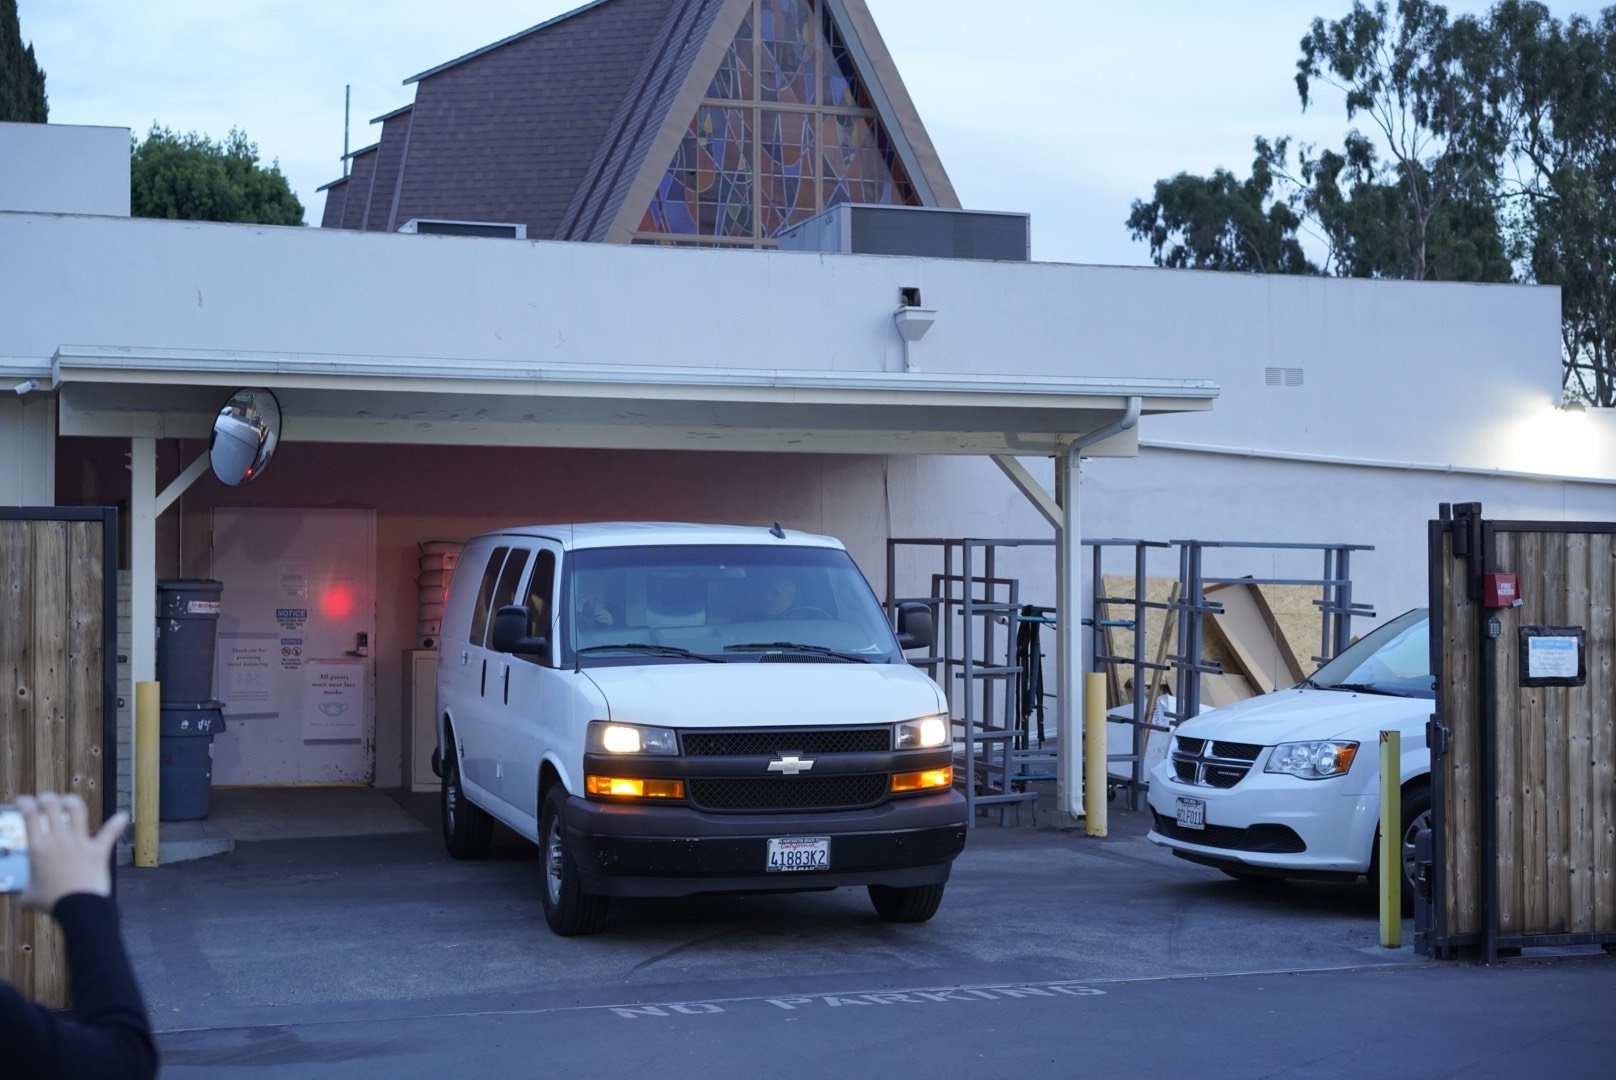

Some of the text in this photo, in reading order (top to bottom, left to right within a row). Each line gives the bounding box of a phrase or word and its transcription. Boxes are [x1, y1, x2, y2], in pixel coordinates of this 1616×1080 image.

[277, 610, 306, 618] NOTICE
[771, 850, 826, 866] 41883K2
[608, 985, 1107, 1019] NO PARKING
